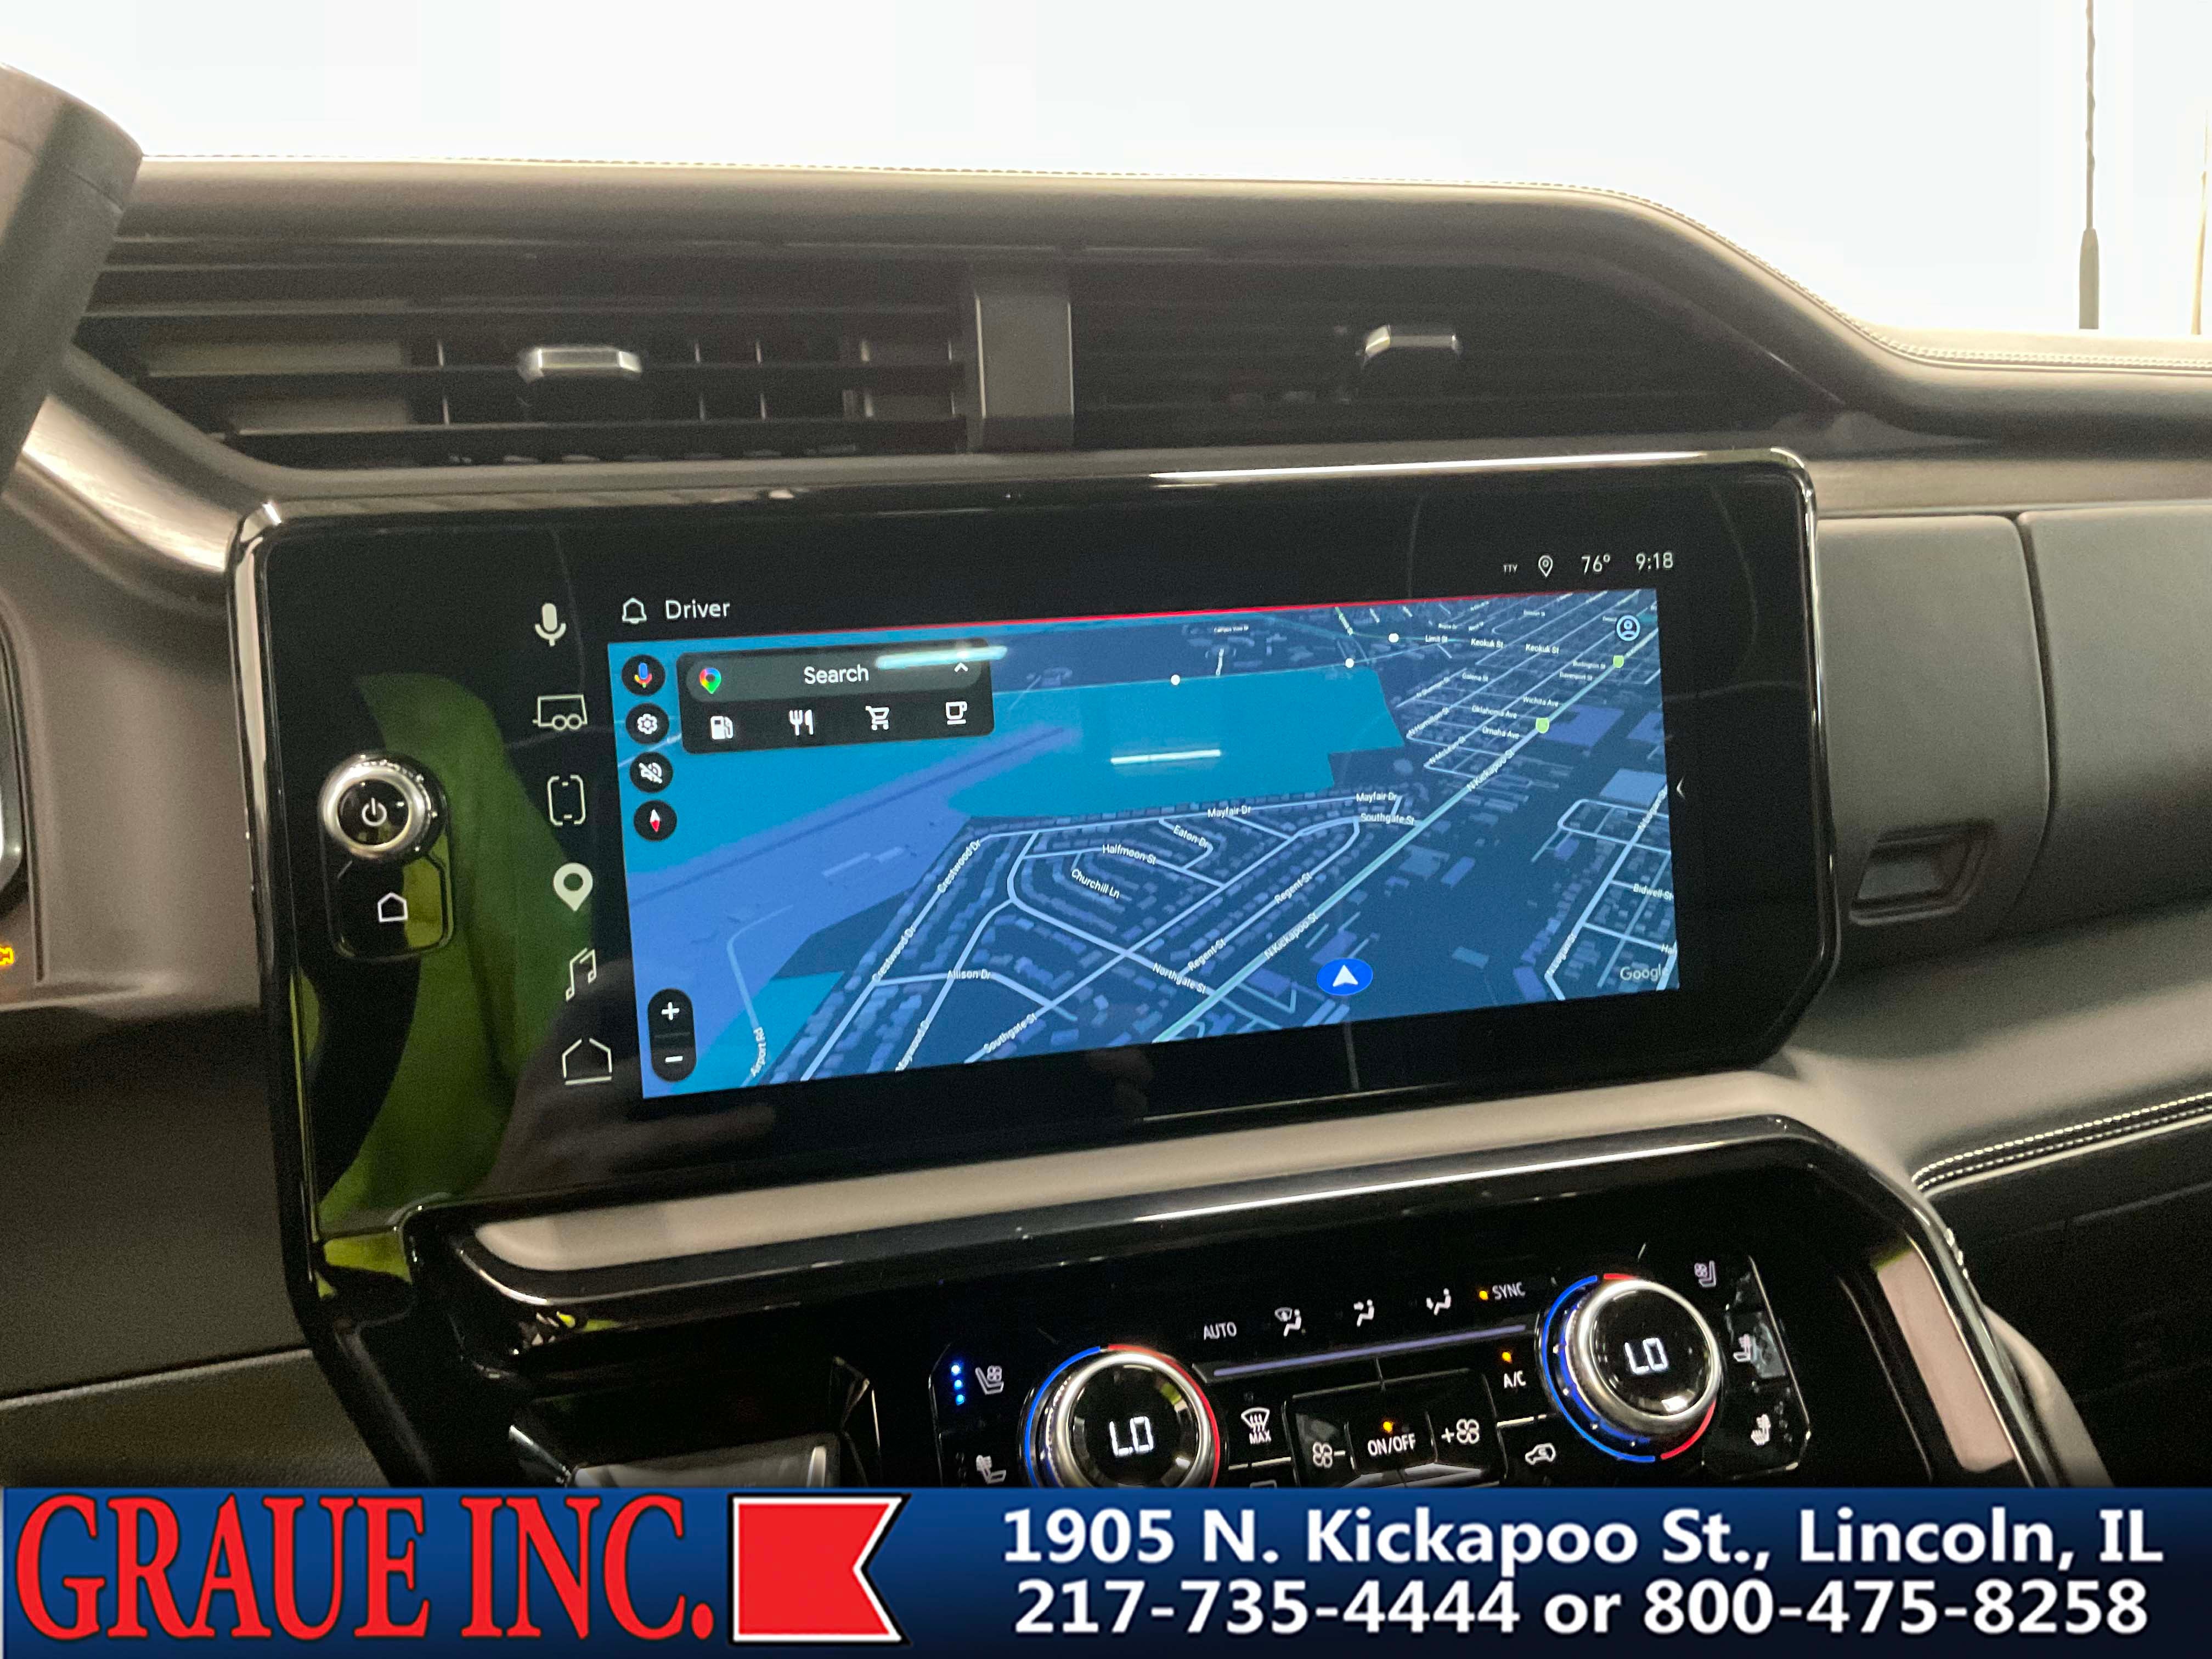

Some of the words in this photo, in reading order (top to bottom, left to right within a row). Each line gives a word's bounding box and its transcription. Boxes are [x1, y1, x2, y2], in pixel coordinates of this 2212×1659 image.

[1503, 564, 1518, 574] TTY
[1636, 551, 1673, 571] 9:18
[665, 600, 730, 620] Driver
[1471, 638, 1495, 648] Keokuk
[1496, 640, 1504, 649] St
[1526, 644, 1550, 653] Keokuk
[1551, 645, 1559, 654] St
[804, 665, 870, 685] Search
[1462, 673, 1482, 681] Galena
[1560, 672, 1585, 680] Davenport
[1523, 696, 1544, 706] Wichita
[1545, 698, 1559, 707] Ave
[1471, 704, 1504, 717] Oklahoma
[1504, 708, 1517, 719] Ave
[1482, 727, 1506, 737] Omaha
[1506, 731, 1520, 740] Ave
[1474, 754, 1507, 787] Kickapoo
[1505, 748, 1515, 759] St
[1356, 792, 1387, 803] Mayfair
[1388, 792, 1398, 801] Dr
[1207, 806, 1239, 818] Mayfair
[1241, 805, 1251, 814] Dr
[1361, 813, 1406, 825] Southgate
[1406, 816, 1414, 826] St
[1173, 825, 1199, 844] Eaton
[1198, 836, 1209, 849] Dr
[1102, 844, 1147, 861] Halfmoon
[1146, 854, 1157, 866] St
[937, 847, 972, 894] Crestwood
[969, 839, 981, 851] Dr
[1071, 868, 1109, 894] Churchill
[1108, 886, 1120, 900] Ln
[1274, 877, 1304, 904] Regent
[1301, 872, 1313, 884] St
[1633, 882, 1663, 898] Bidwell
[1269, 920, 1310, 955] Kickapoo
[1307, 912, 1319, 924] St
[872, 935, 909, 981] Crestwood
[1187, 944, 1218, 972] Regent
[1215, 938, 1227, 950] St
[947, 970, 979, 979] Allison
[1153, 962, 1197, 989] Northgate
[1196, 983, 1207, 994] St
[753, 1026, 766, 1042] Rd
[984, 1018, 1028, 1054] Southgate
[1026, 1013, 1036, 1024] St
[750, 1042, 766, 1077] Airport
[1492, 1282, 1527, 1300] SYNC
[1204, 1321, 1237, 1340] AUTO
[1625, 1337, 1668, 1373] LO
[1503, 1370, 1527, 1389] A/C
[1109, 1415, 1154, 1457] LO
[1249, 1429, 1271, 1444] MAX
[1368, 1434, 1417, 1456] ON/OFF
